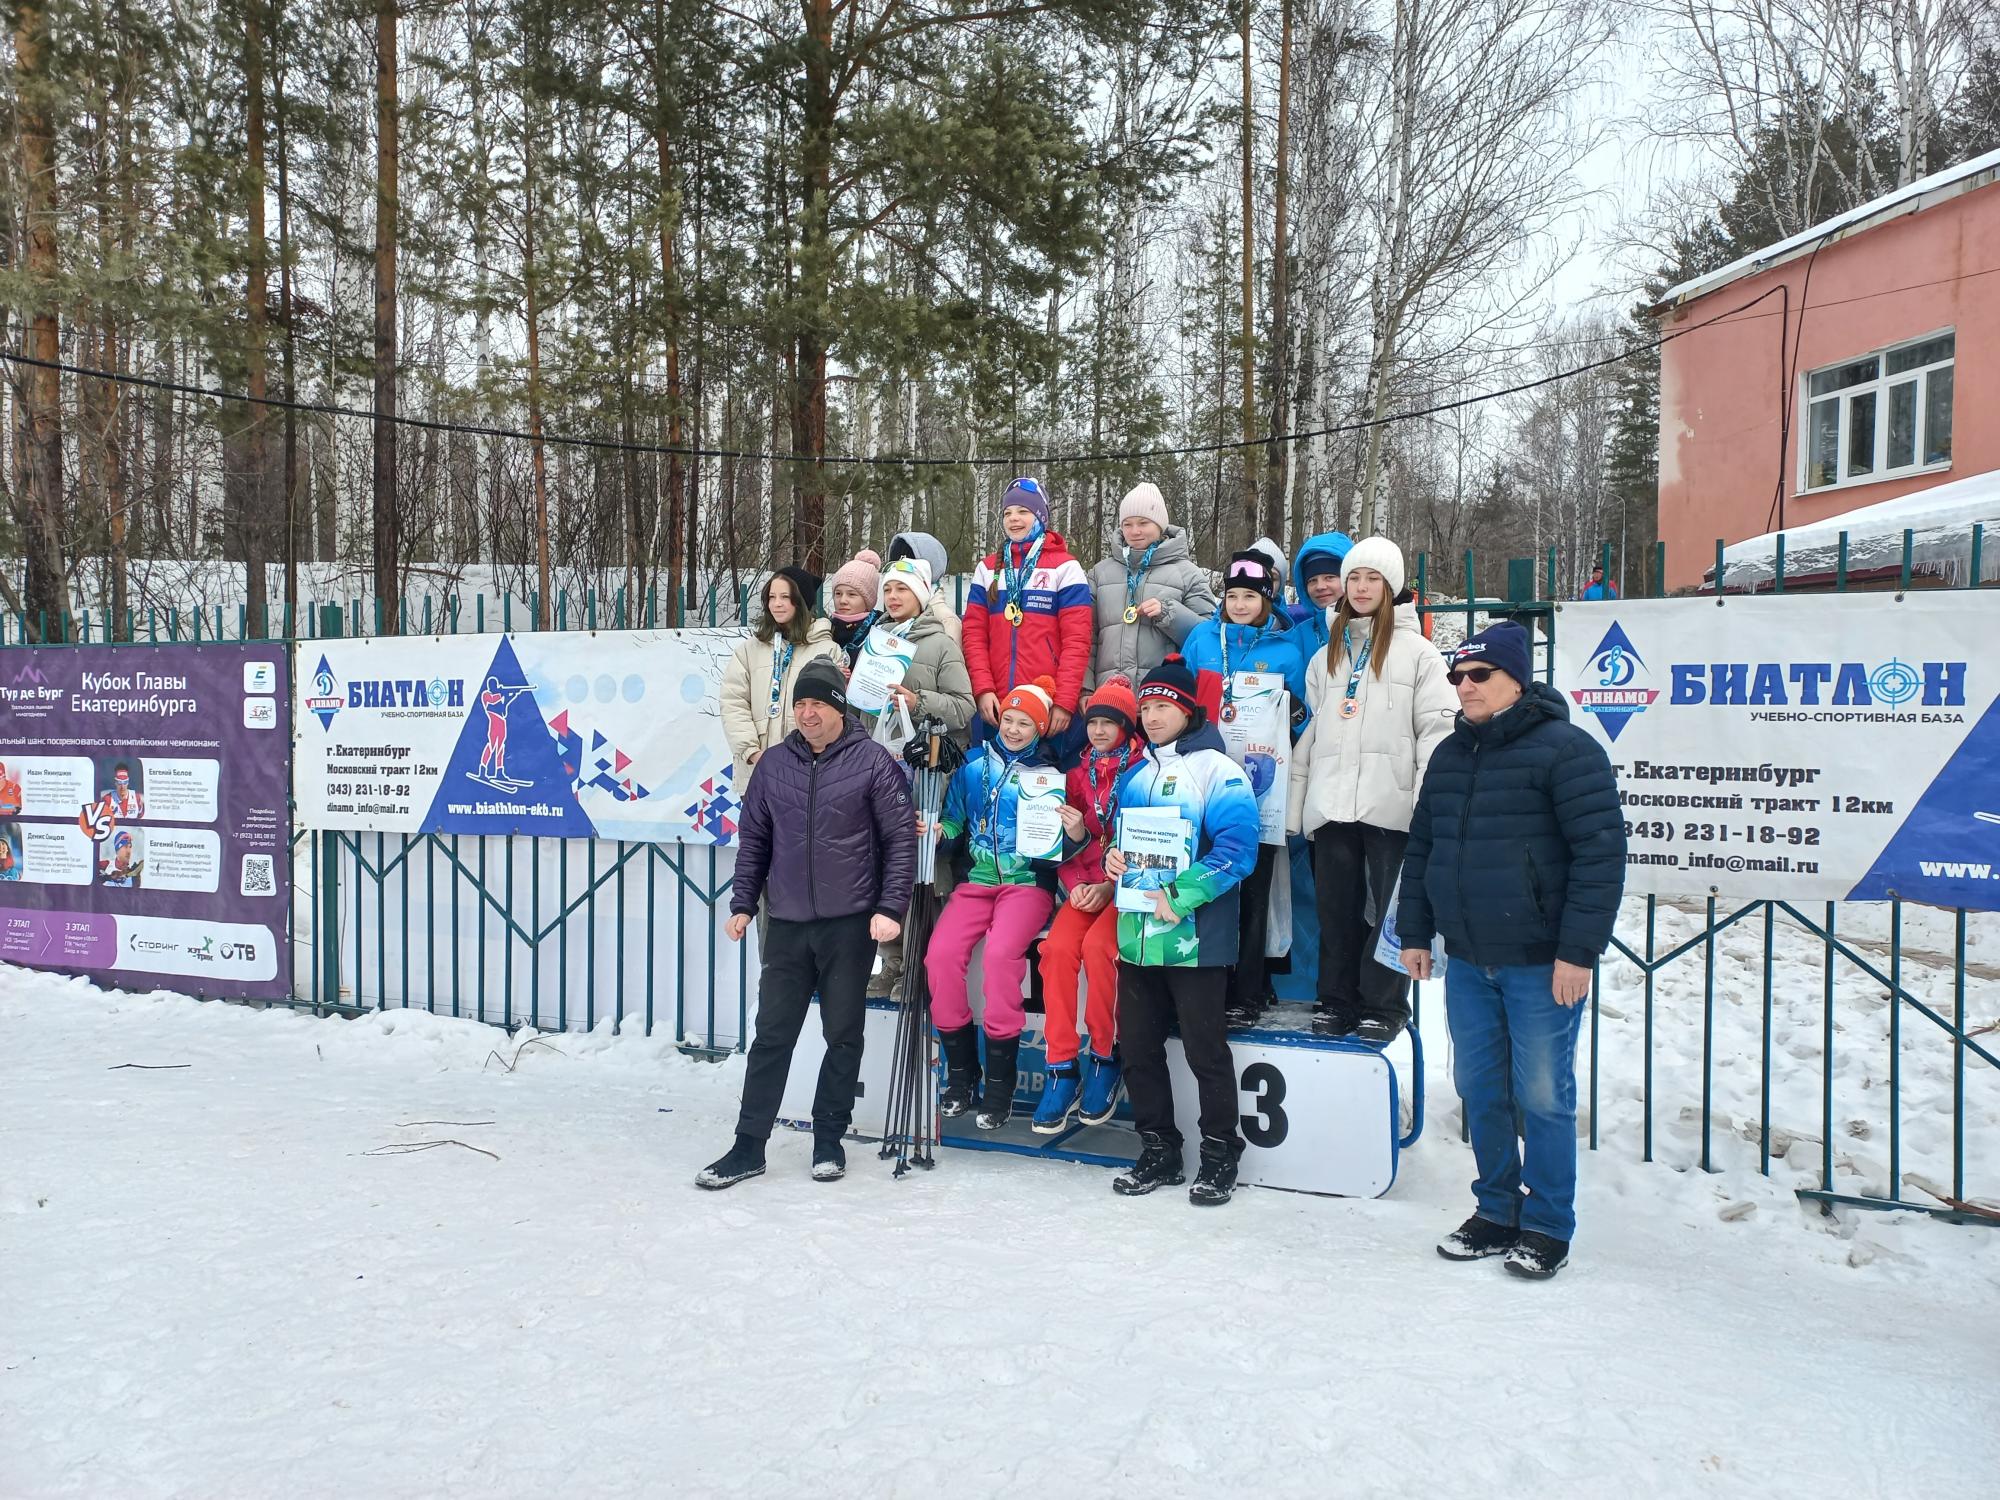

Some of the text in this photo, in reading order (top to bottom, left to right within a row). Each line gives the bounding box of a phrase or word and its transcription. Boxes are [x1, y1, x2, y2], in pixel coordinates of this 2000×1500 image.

[82, 672, 186, 694] Кубок Главы
[0, 686, 64, 701] Тур де Бург
[1138, 686, 1179, 701] USSIA
[71, 694, 197, 716] Екатеринбурга
[1750, 711, 1965, 724] УЧЕБНО-СПОРТИВНАЯ БАЗА
[113, 737, 168, 747] олимпийскими
[326, 744, 411, 759] г.Екатеринбург
[327, 763, 438, 777] Московский тракт 12км
[1611, 760, 1821, 787] г.Екатеринбург
[327, 783, 410, 796] (343) 231-18-92
[327, 802, 410, 815] dinamo_info@mail.ru
[447, 801, 564, 817] www.biathlon-ekb.ru
[1026, 804, 1055, 812] ДИПЛОМ
[1751, 797, 1821, 815] тракт
[1832, 795, 1894, 814] 12км
[82, 800, 112, 842] VS
[1623, 820, 1820, 846] 343) 231-18-92
[1626, 851, 1819, 874] namo_info@mail.ru
[13, 919, 31, 928] ЭТАП
[71, 923, 90, 932] ЭТАП
[138, 940, 180, 951] СТОРИНГ
[1241, 1062, 1289, 1148] 3
